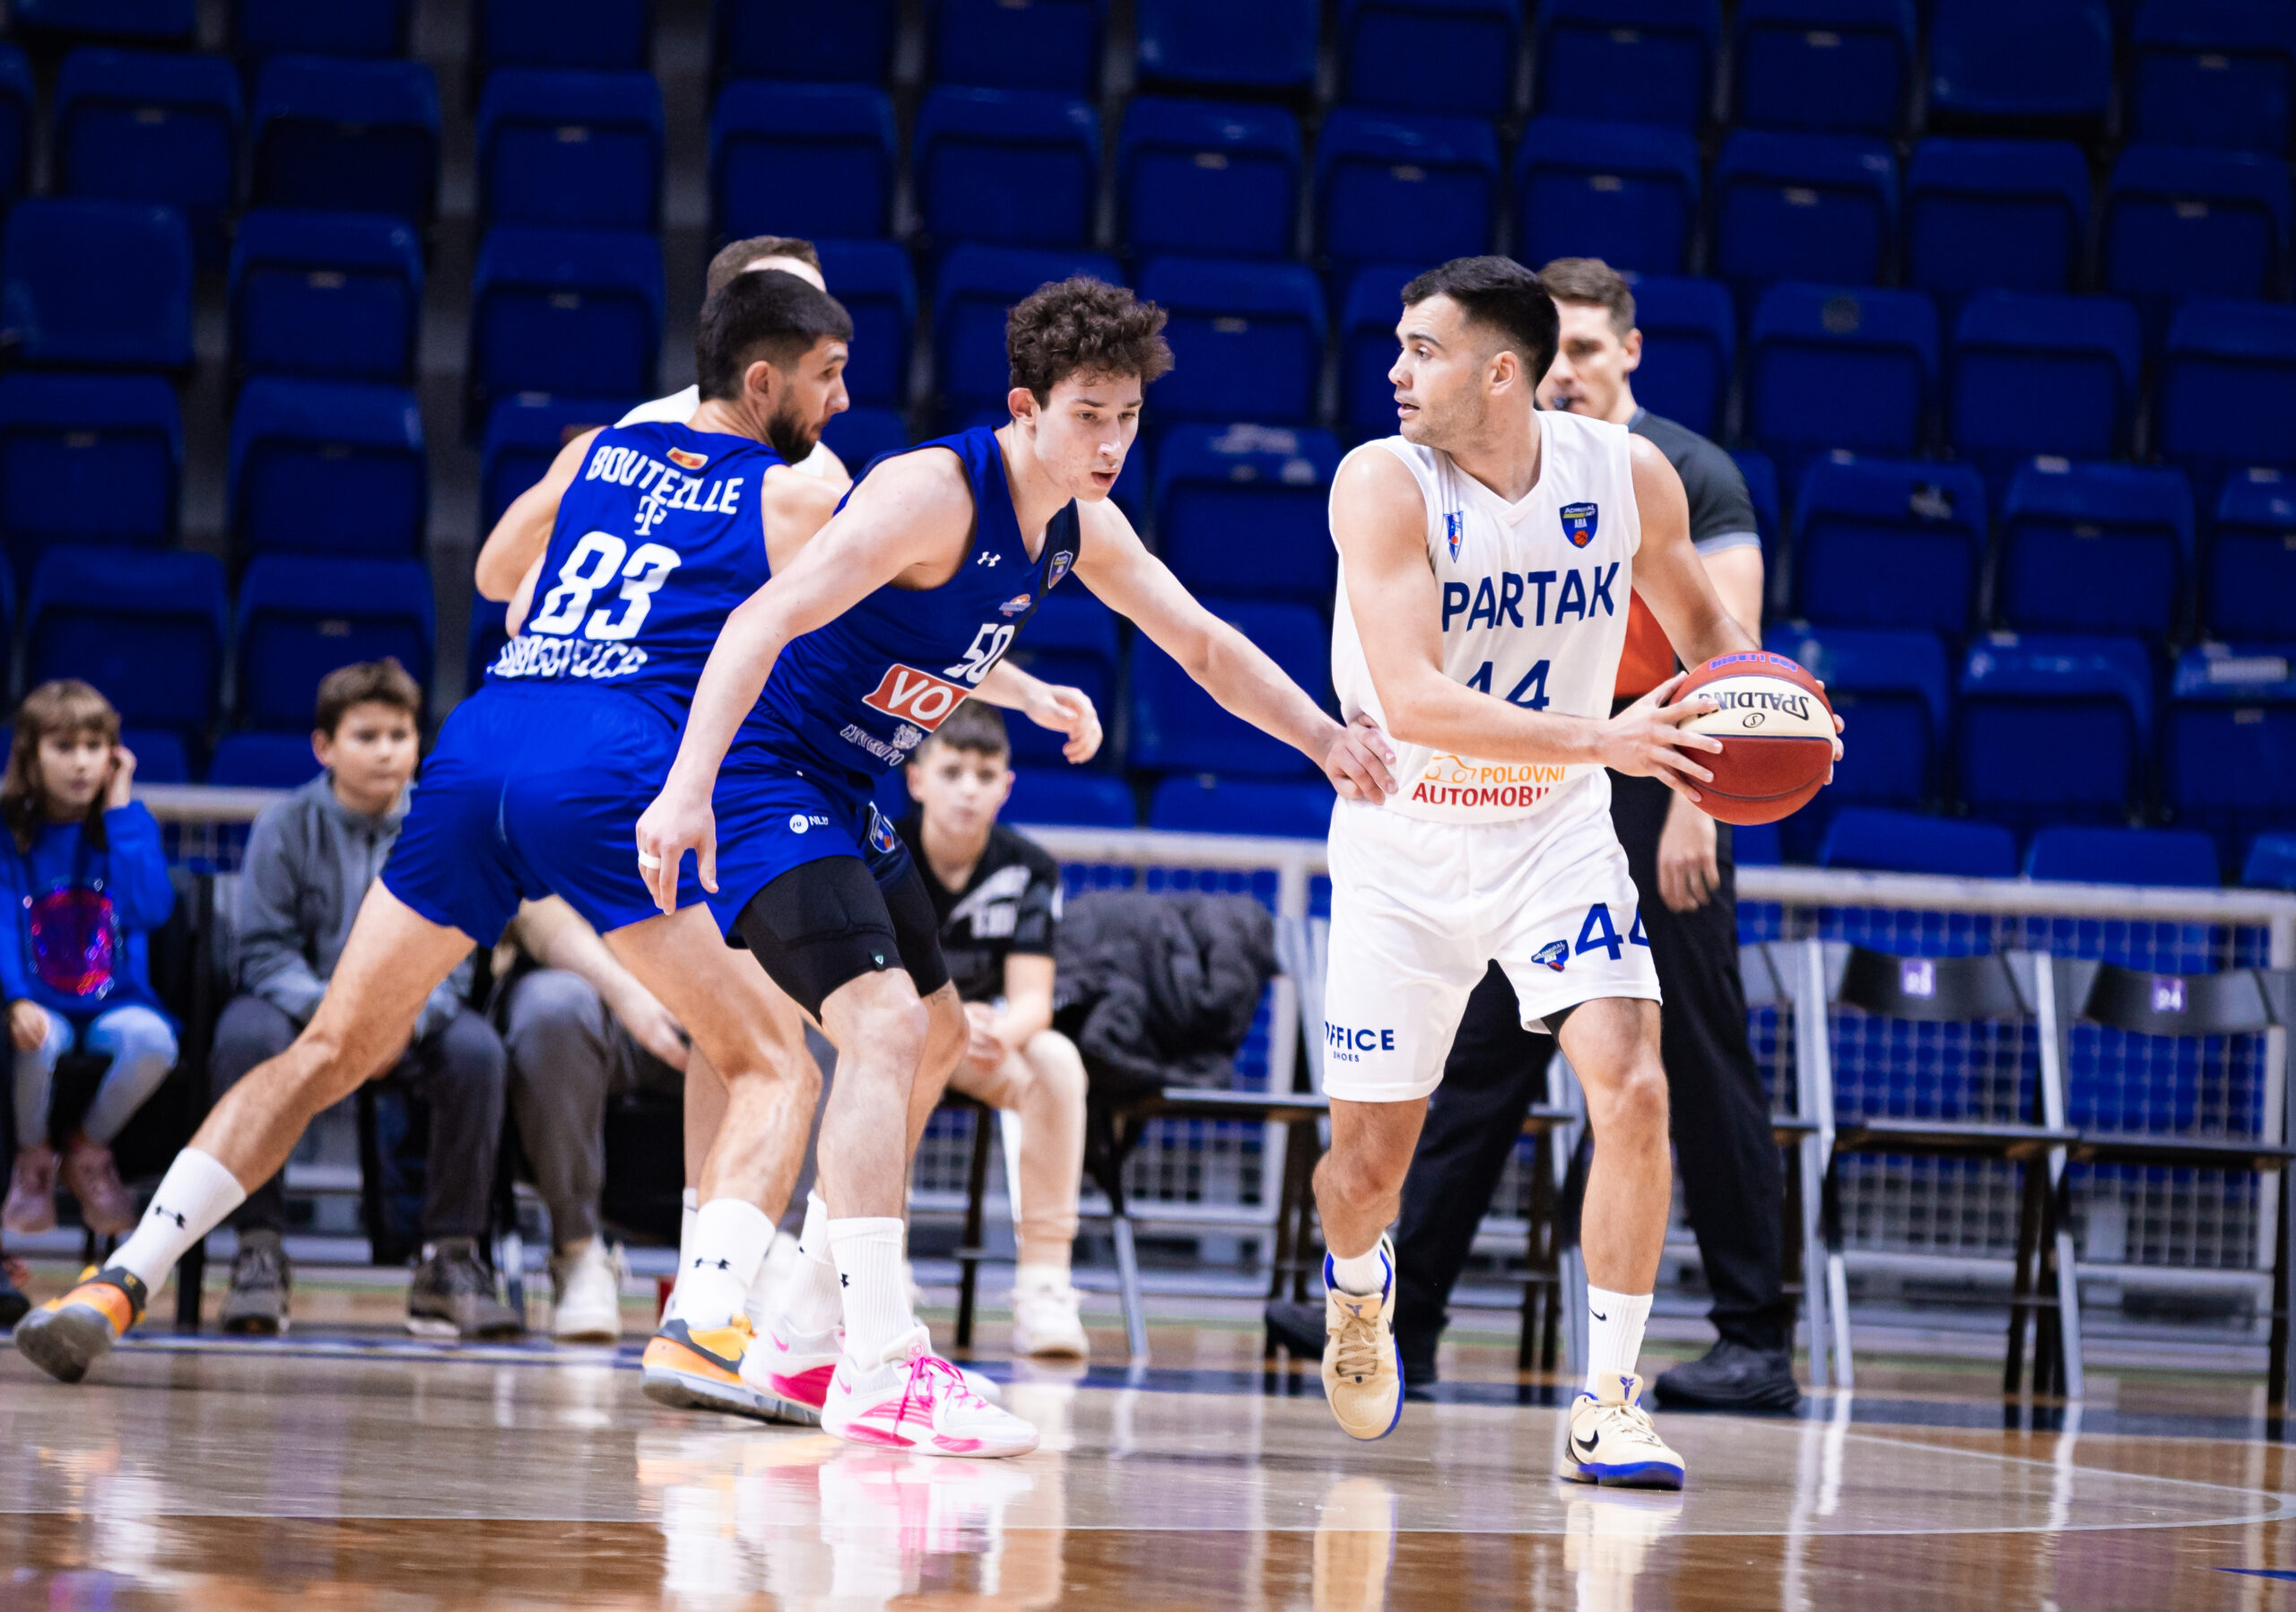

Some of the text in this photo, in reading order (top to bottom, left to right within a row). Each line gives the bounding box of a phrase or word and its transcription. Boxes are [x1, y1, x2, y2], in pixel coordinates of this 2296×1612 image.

[586, 446, 744, 515] BOUTEILLE
[529, 531, 682, 640] 83
[1441, 562, 1620, 632] PARTAK
[943, 623, 1014, 684] 50
[1481, 765, 1566, 784] POLOVNI
